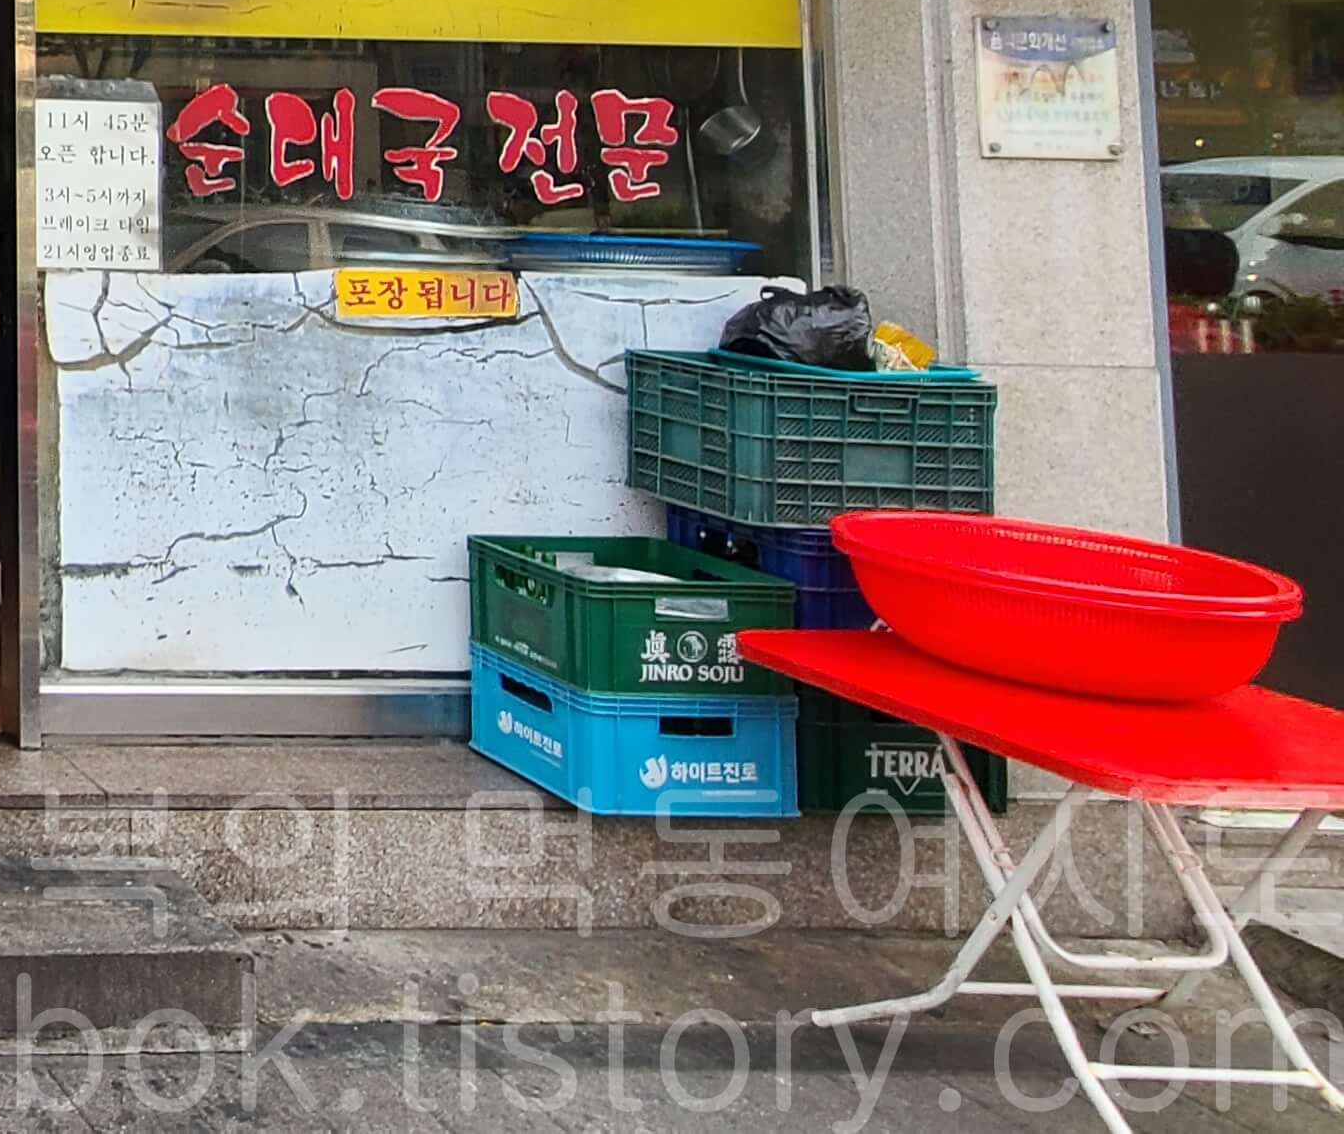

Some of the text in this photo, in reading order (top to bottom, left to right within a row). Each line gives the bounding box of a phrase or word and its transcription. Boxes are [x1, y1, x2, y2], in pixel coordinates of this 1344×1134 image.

[38, 145, 155, 166] 오픈 합니다.
[166, 83, 679, 206] 순대국 전문
[638, 664, 745, 684] JINRO SOJU
[512, 721, 563, 759] 하이트진로
[670, 761, 759, 785] 하이트진로
[864, 745, 946, 778] TERRA
